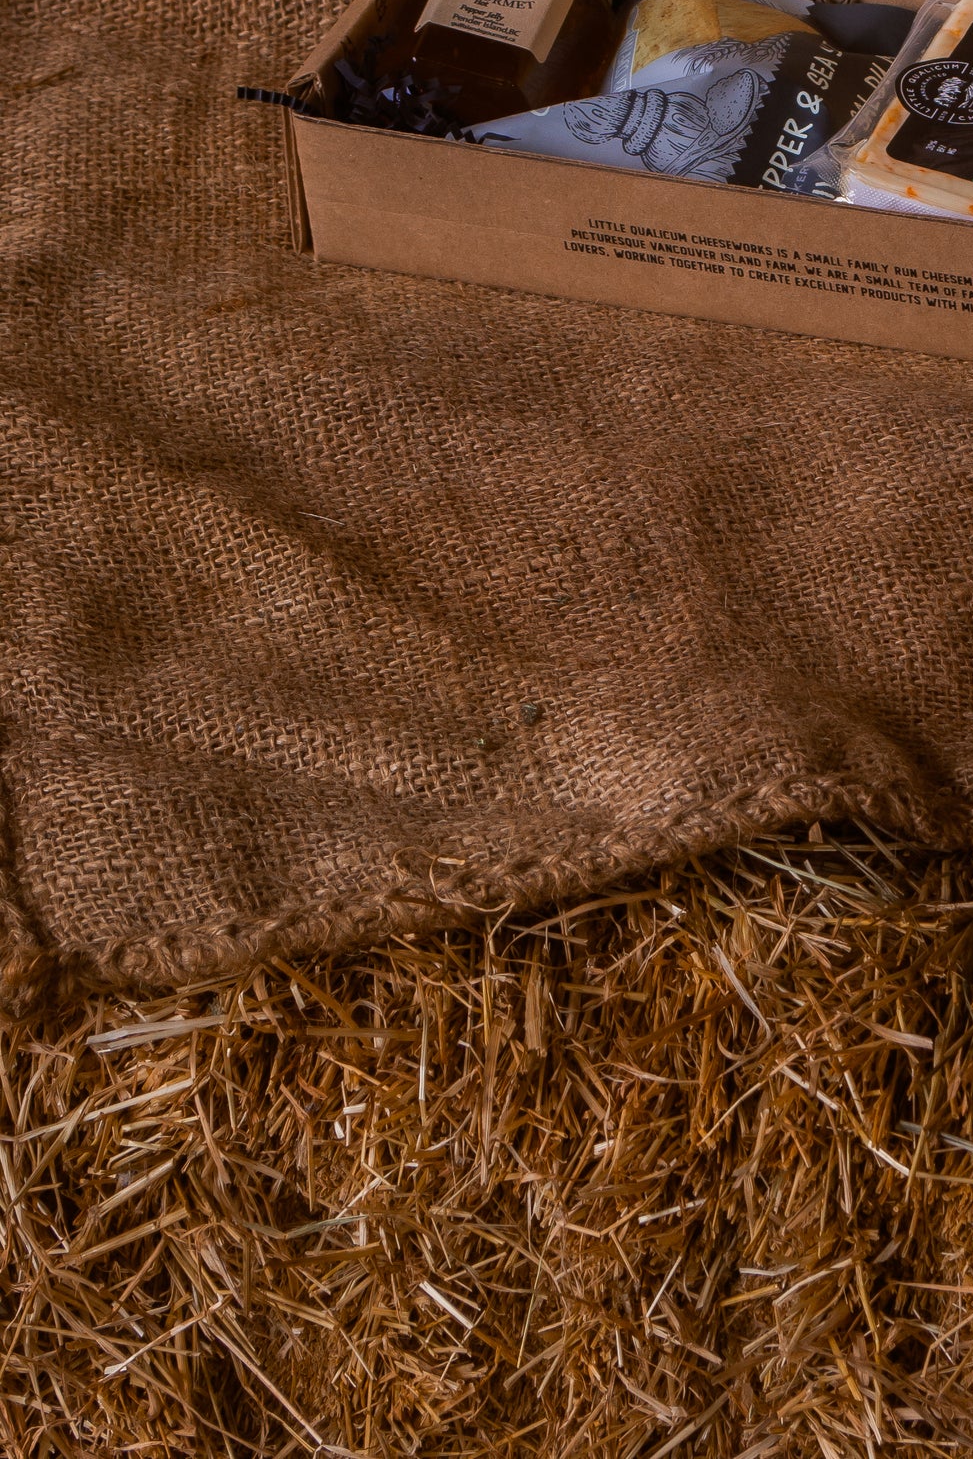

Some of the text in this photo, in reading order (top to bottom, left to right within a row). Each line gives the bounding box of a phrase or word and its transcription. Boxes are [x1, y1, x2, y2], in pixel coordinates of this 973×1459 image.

[452, 13, 481, 26] Pender
[460, 4, 487, 17] Pepper
[807, 56, 839, 90] SEA
[906, 63, 960, 114] LITTLE QUALICUM
[797, 91, 823, 114] &
[758, 118, 813, 190] PPER
[571, 229, 646, 249] PICTURESQUE
[650, 241, 716, 260] VANCOUVER
[720, 252, 761, 267] ISLAND
[766, 259, 800, 273] FARM.
[804, 265, 822, 276] WE
[827, 269, 848, 281] ARE
[853, 273, 861, 282] A
[865, 275, 903, 289] SMALL
[908, 281, 939, 294] TEAM
[943, 287, 957, 297] OF
[588, 218, 626, 233] LITTLE
[630, 225, 688, 243] QUALICUM
[691, 235, 773, 256] CHEESEWORKS
[777, 248, 788, 258] IS
[793, 250, 801, 260] A
[805, 252, 844, 267] SMALL
[847, 259, 889, 274] FAMILY
[894, 266, 917, 279] RUN
[613, 248, 665, 265] WORKING
[669, 257, 725, 275] TOGETHER
[729, 266, 745, 277] TO
[749, 270, 791, 285] CREATE
[795, 277, 856, 295] EXCELLENT
[861, 287, 921, 305] PRODUCTS
[925, 297, 957, 310] WITH
